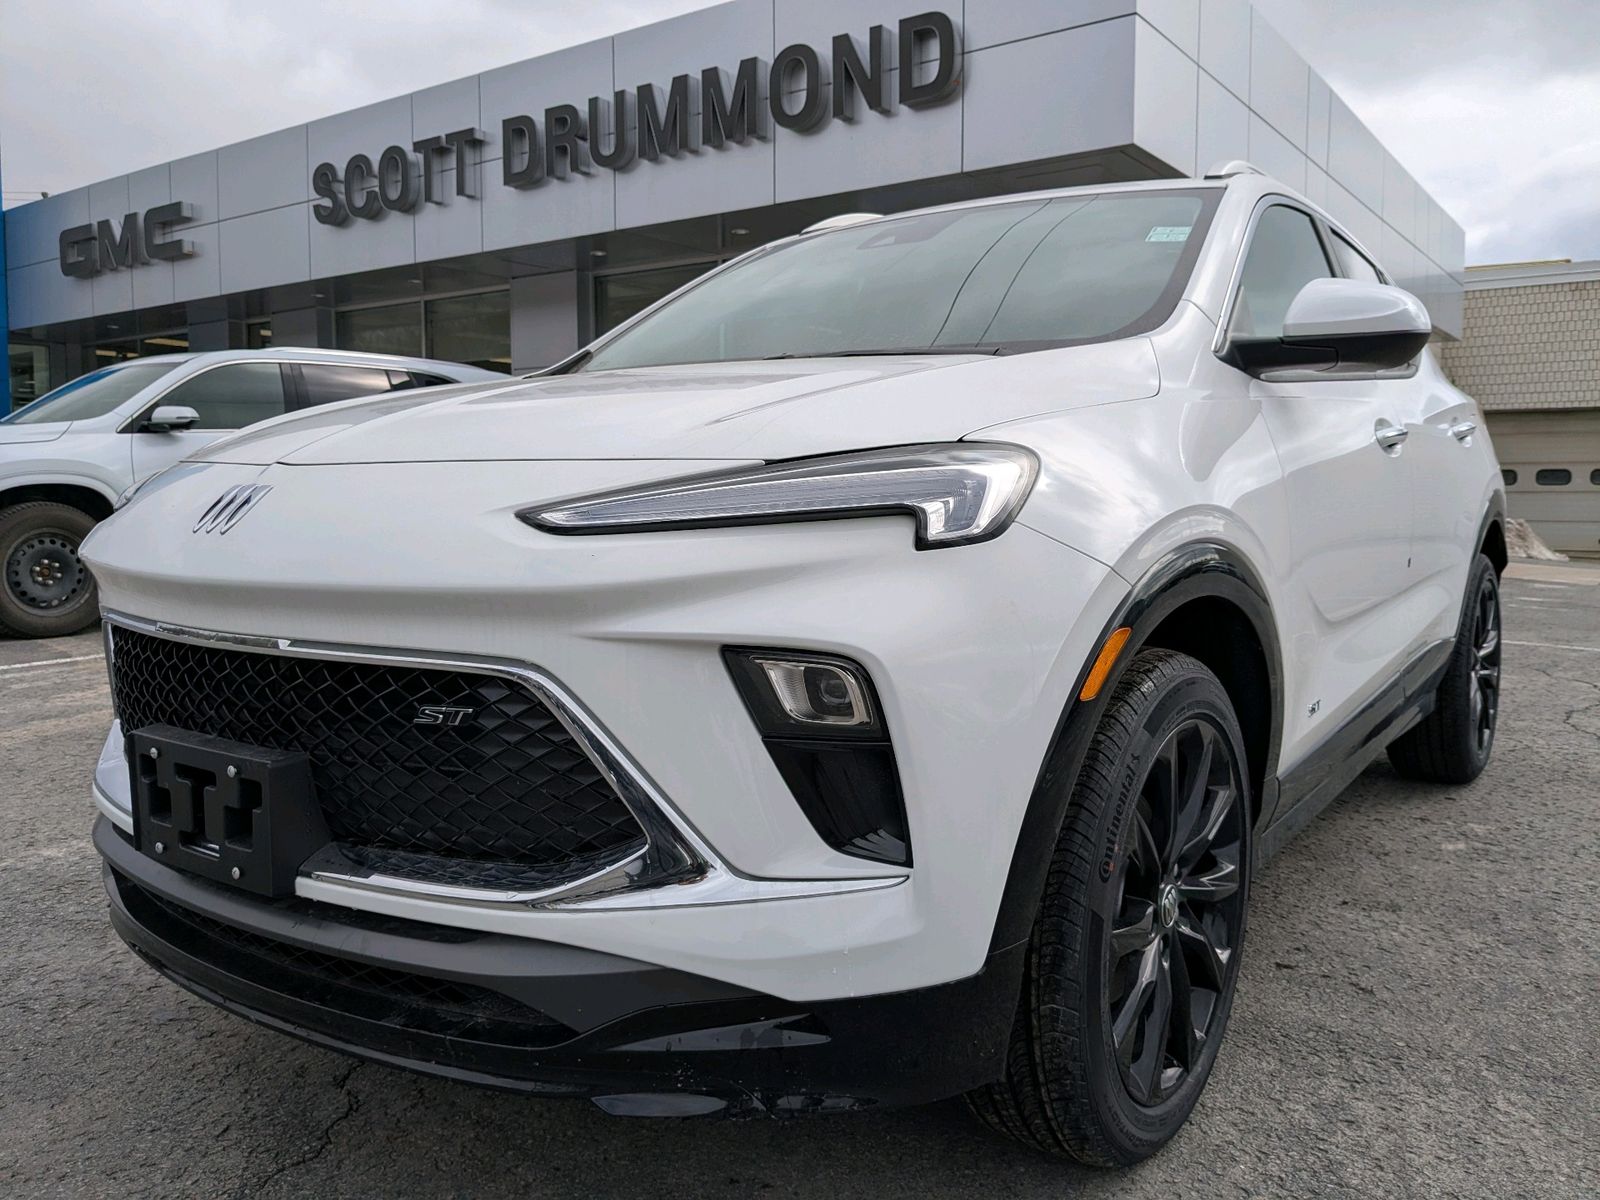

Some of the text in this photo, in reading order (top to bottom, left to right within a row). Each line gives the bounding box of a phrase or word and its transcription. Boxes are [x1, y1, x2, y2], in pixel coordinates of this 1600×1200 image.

[312, 11, 962, 227] SCOTT DRUMMOND
[59, 200, 191, 278] GMC
[413, 705, 474, 726] ST
